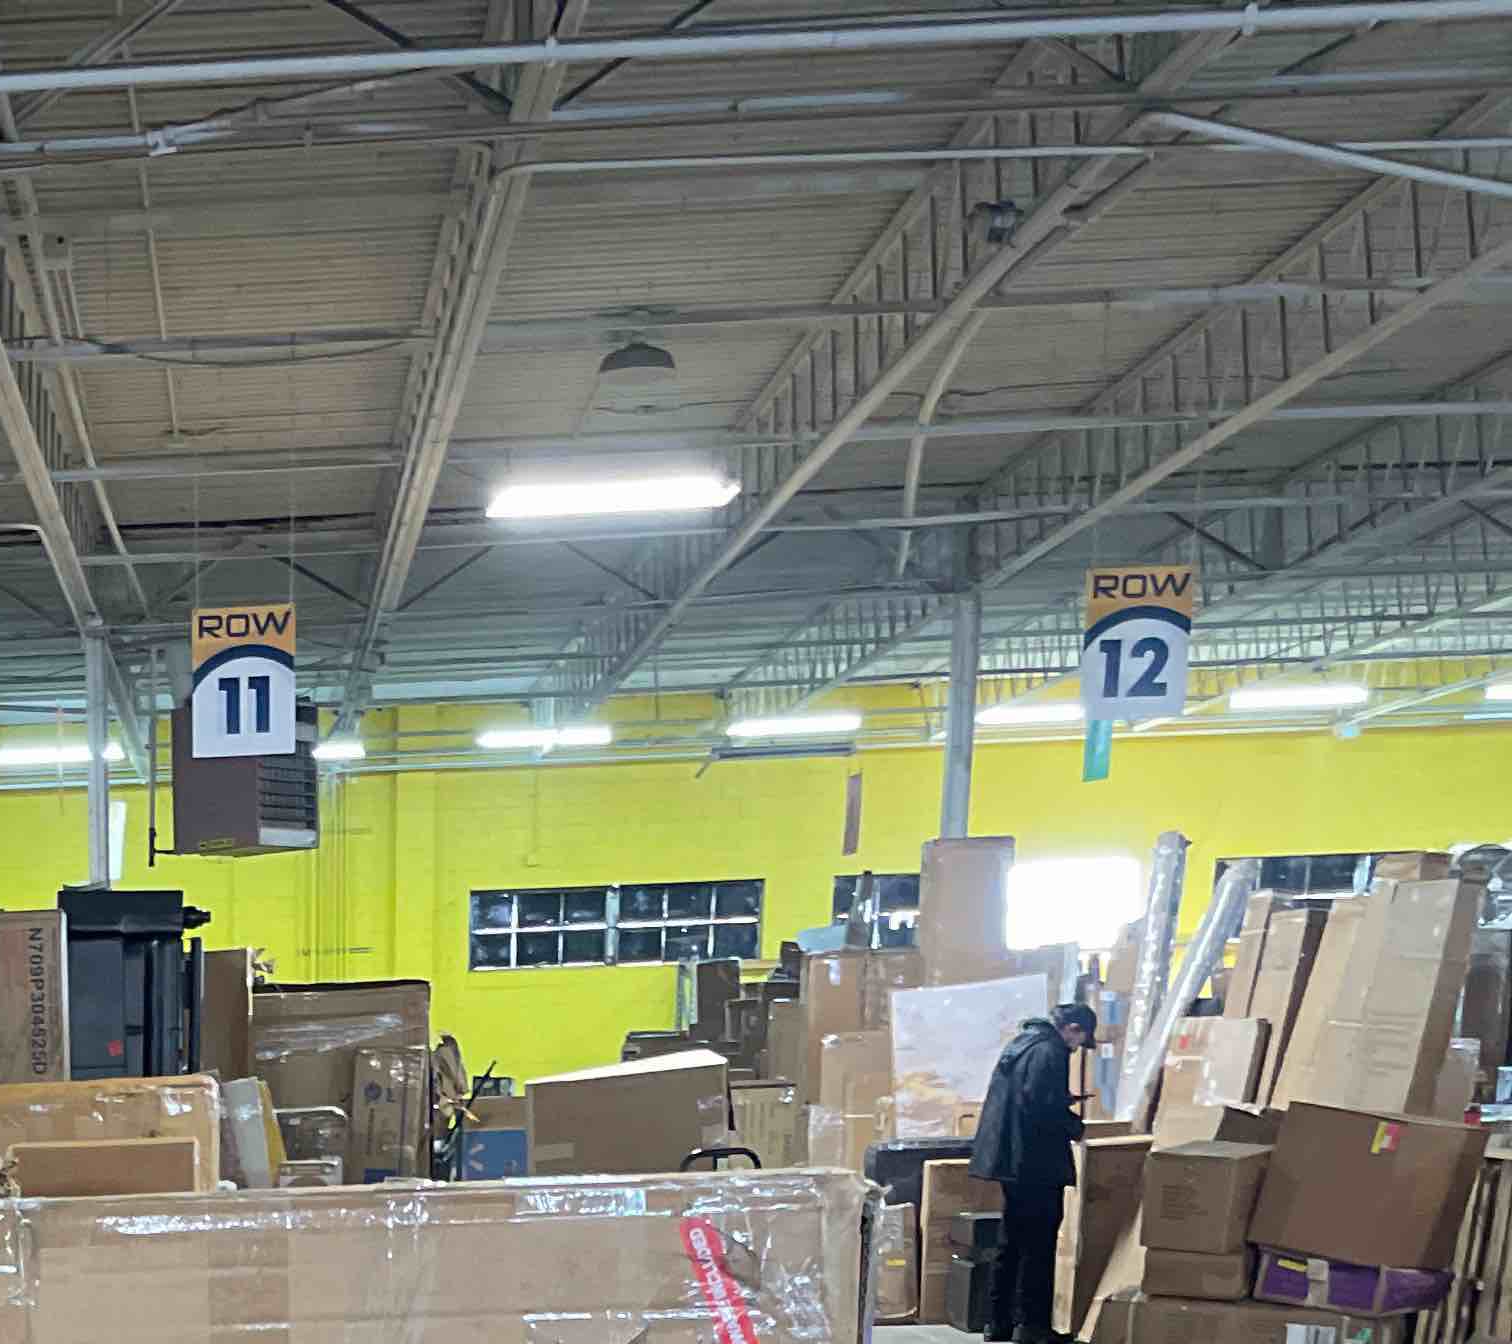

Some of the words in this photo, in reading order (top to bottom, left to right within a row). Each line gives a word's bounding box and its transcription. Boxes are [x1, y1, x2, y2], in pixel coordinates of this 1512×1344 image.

[1093, 572, 1191, 599] ROW
[198, 610, 291, 639] ROW
[1099, 636, 1169, 698] 12
[218, 675, 270, 734] 11
